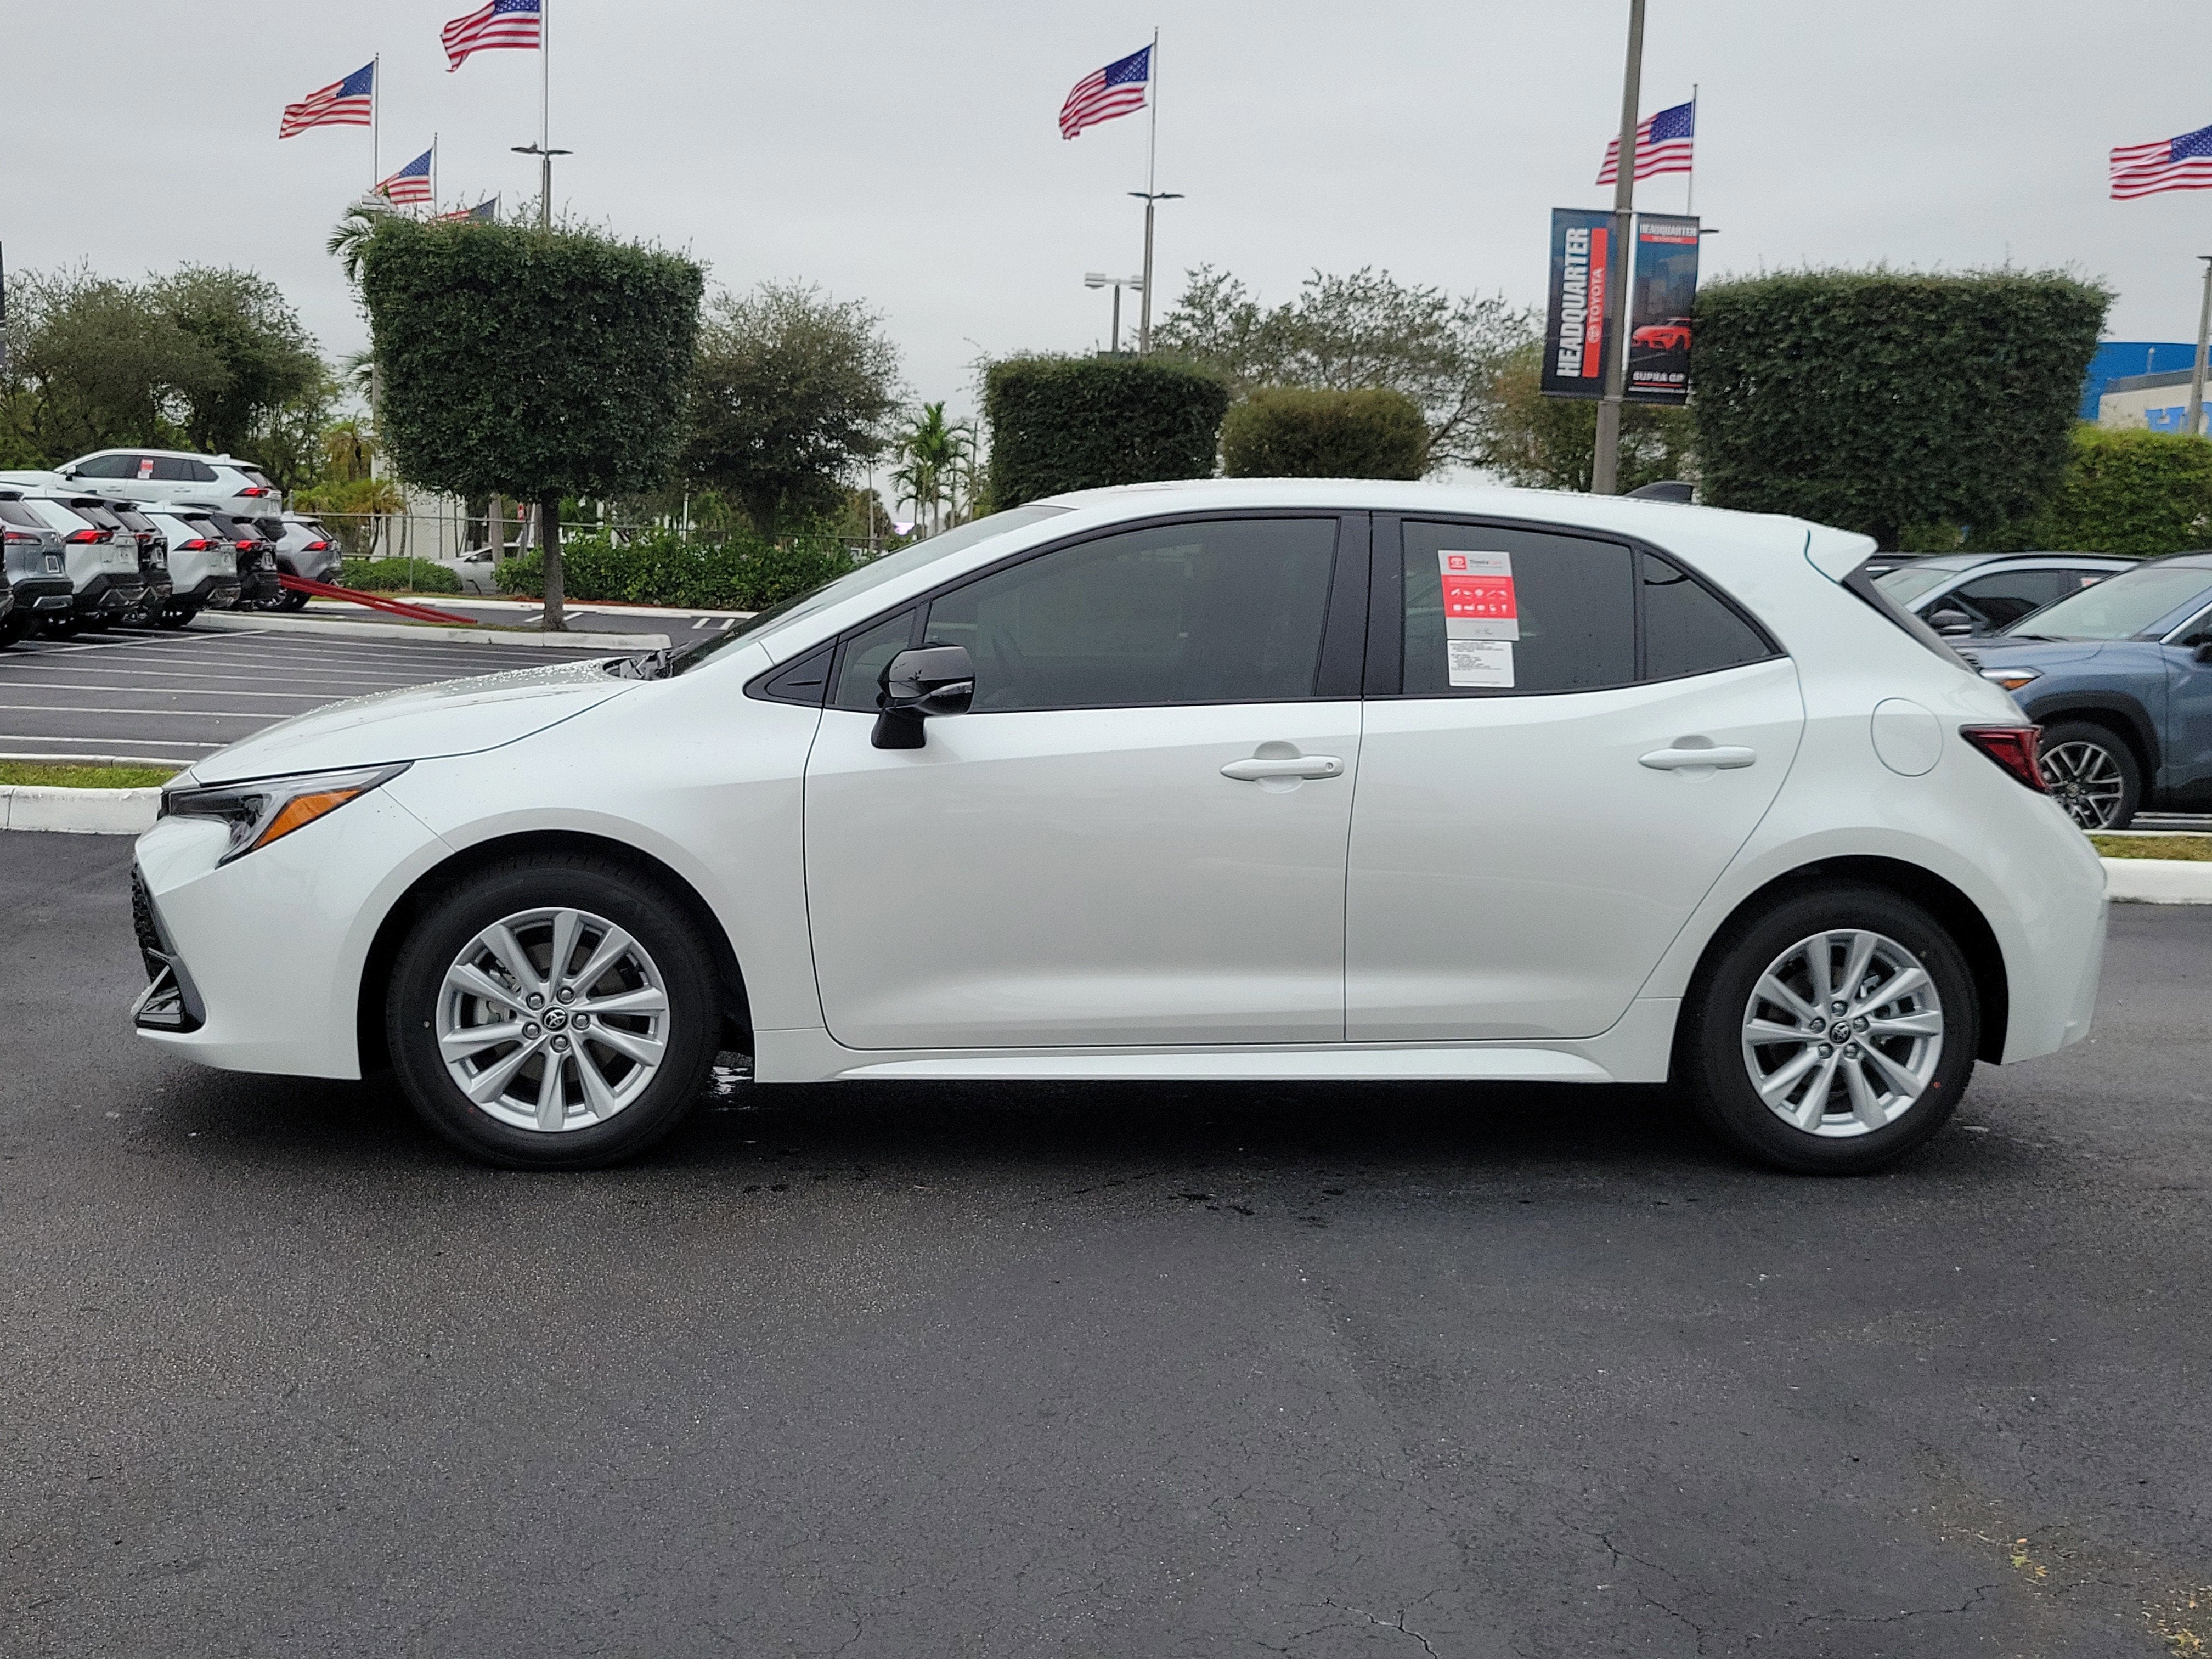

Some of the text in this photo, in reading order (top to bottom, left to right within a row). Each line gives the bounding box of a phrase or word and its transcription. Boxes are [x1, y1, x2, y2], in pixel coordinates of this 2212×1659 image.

[1556, 227, 1590, 377] HEADQUARTER
[1589, 267, 1604, 324] TOYOTA
[1633, 371, 1668, 382] SUPRA
